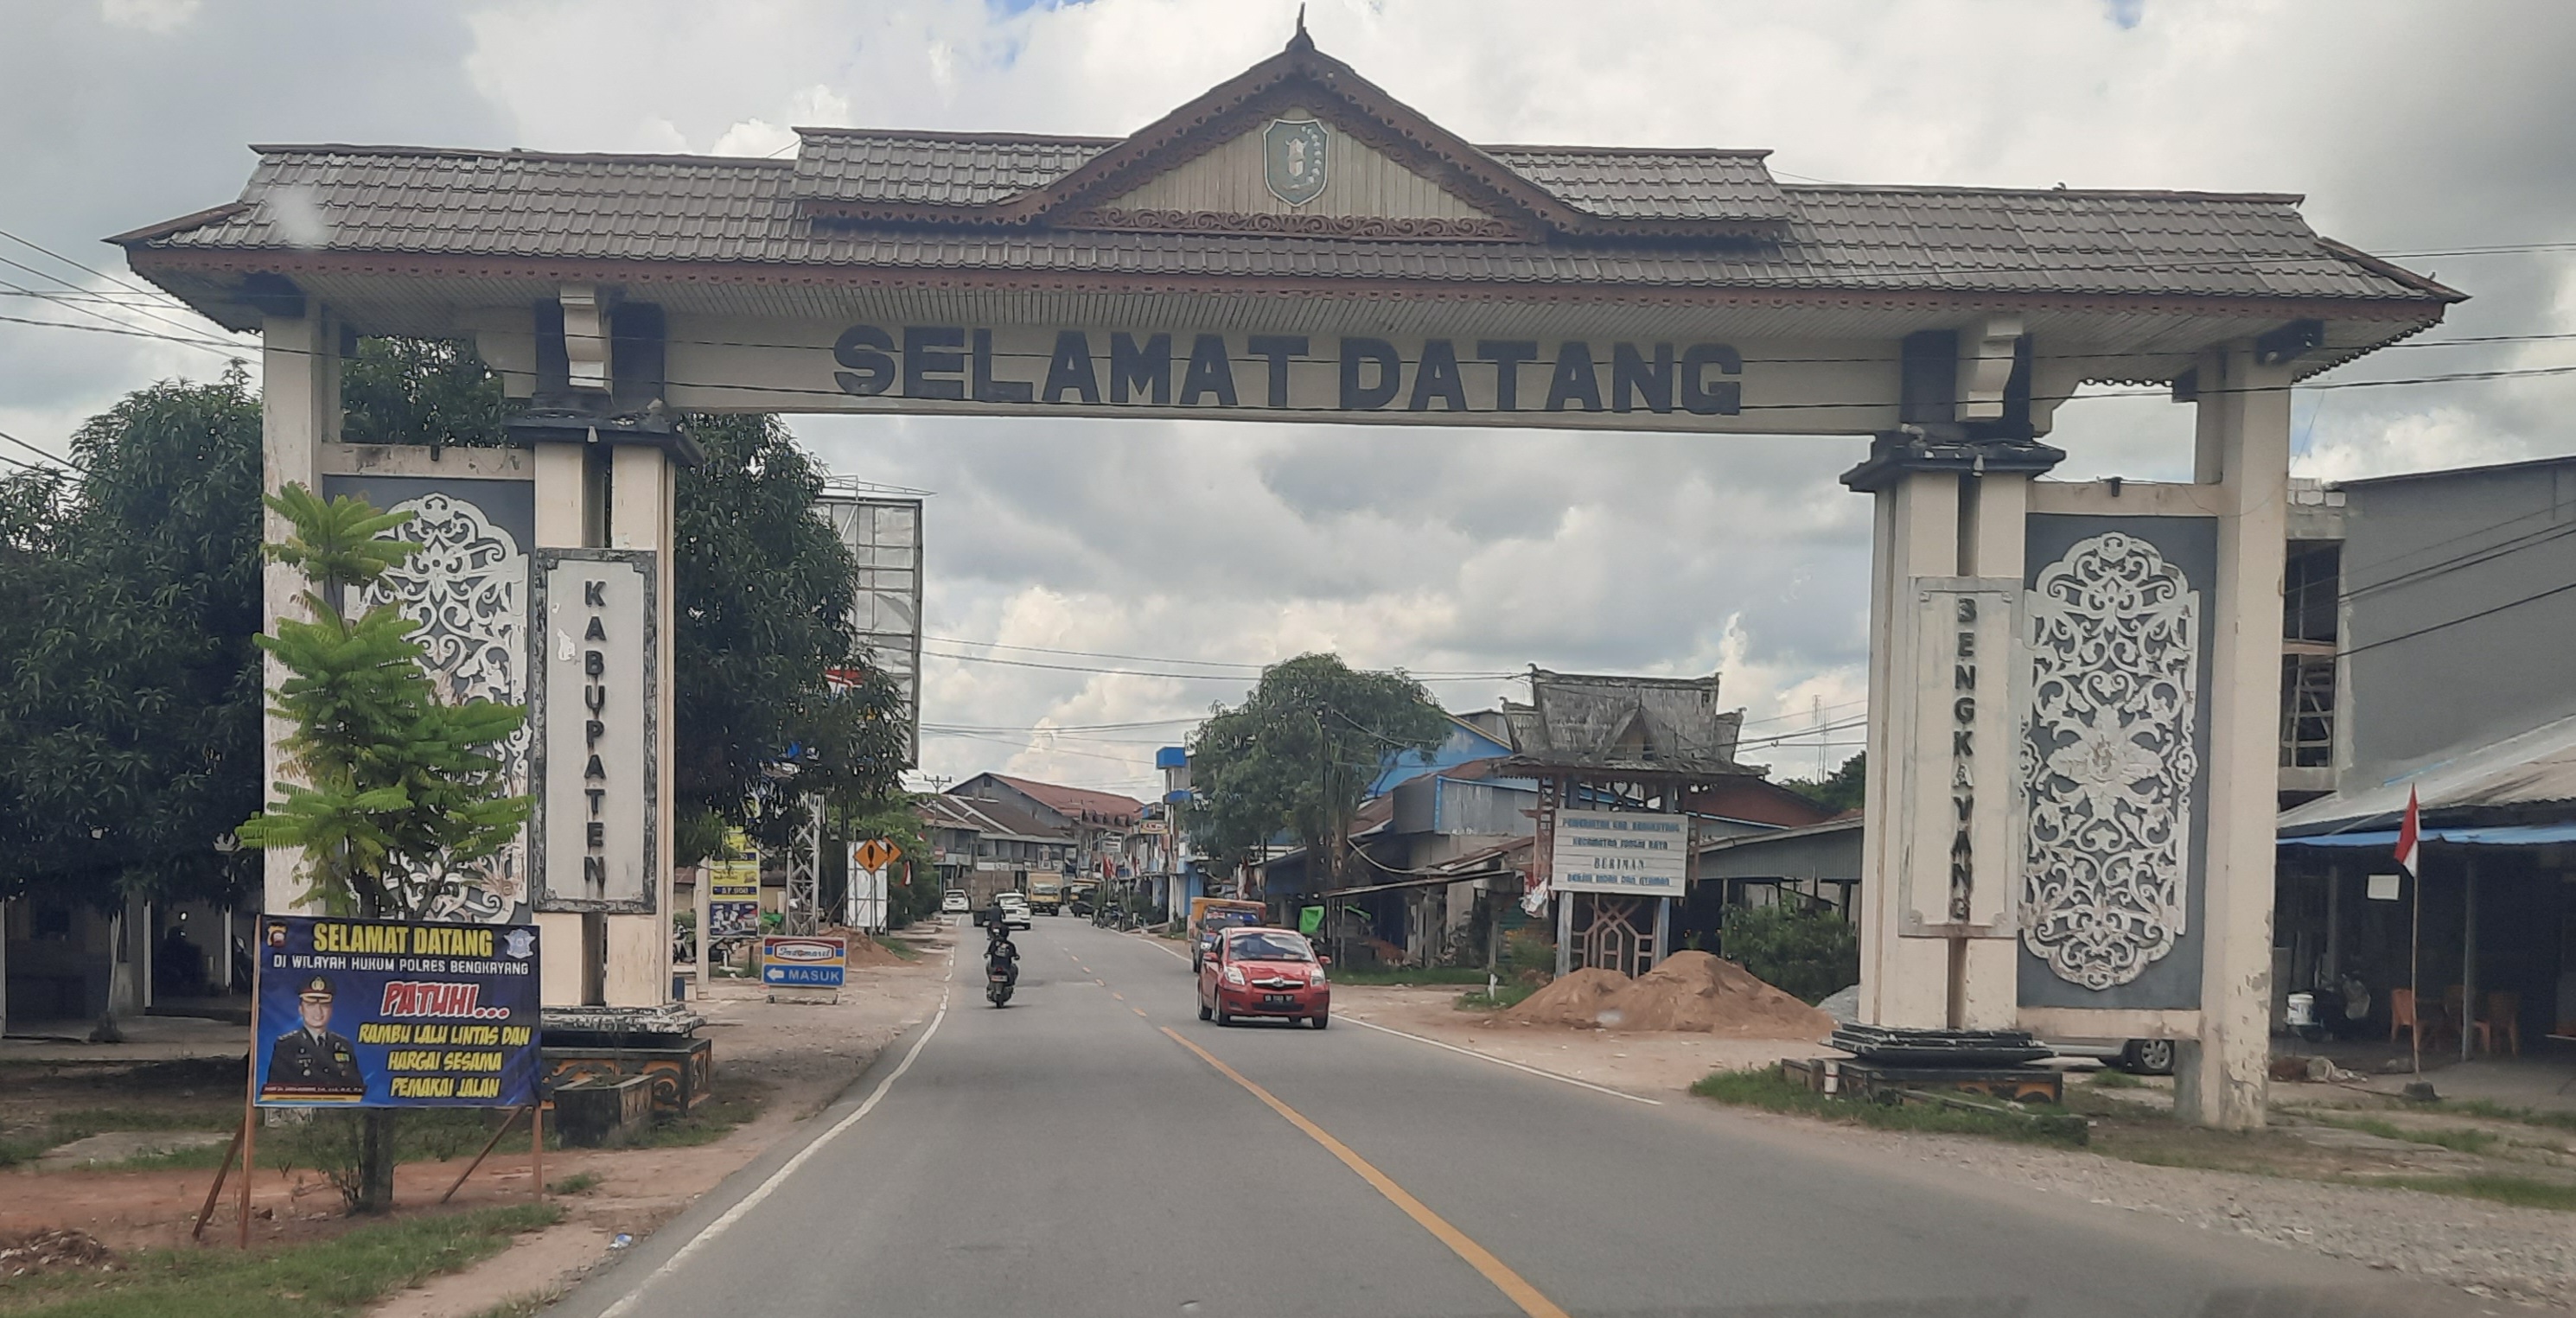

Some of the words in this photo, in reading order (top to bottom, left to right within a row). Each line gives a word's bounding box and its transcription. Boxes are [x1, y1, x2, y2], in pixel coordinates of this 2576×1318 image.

[834, 322, 1310, 406] SELAMAT
[1339, 336, 1744, 416] DATANG
[583, 580, 607, 884] KABUPATEN
[1951, 597, 1977, 920] BENGKAYANG
[313, 922, 410, 954] SELAMAT
[412, 927, 493, 958] DATANG
[273, 954, 287, 968] DI
[292, 954, 347, 970] WILAYAH
[351, 956, 394, 971] HUKUM
[399, 958, 445, 973] POLRES
[450, 960, 529, 975] BENGKAYANG
[788, 970, 840, 982] MASUK
[380, 981, 510, 1020] PATUHI...
[358, 1023, 411, 1045] RAMBU
[413, 1025, 448, 1045] LALU
[450, 1025, 499, 1046] LINTAS
[501, 1026, 532, 1046] DAN
[387, 1051, 442, 1071] HARGAI
[443, 1051, 502, 1072] SESAMA
[391, 1077, 454, 1098] PEMAKAI
[456, 1078, 501, 1098] JALAN
